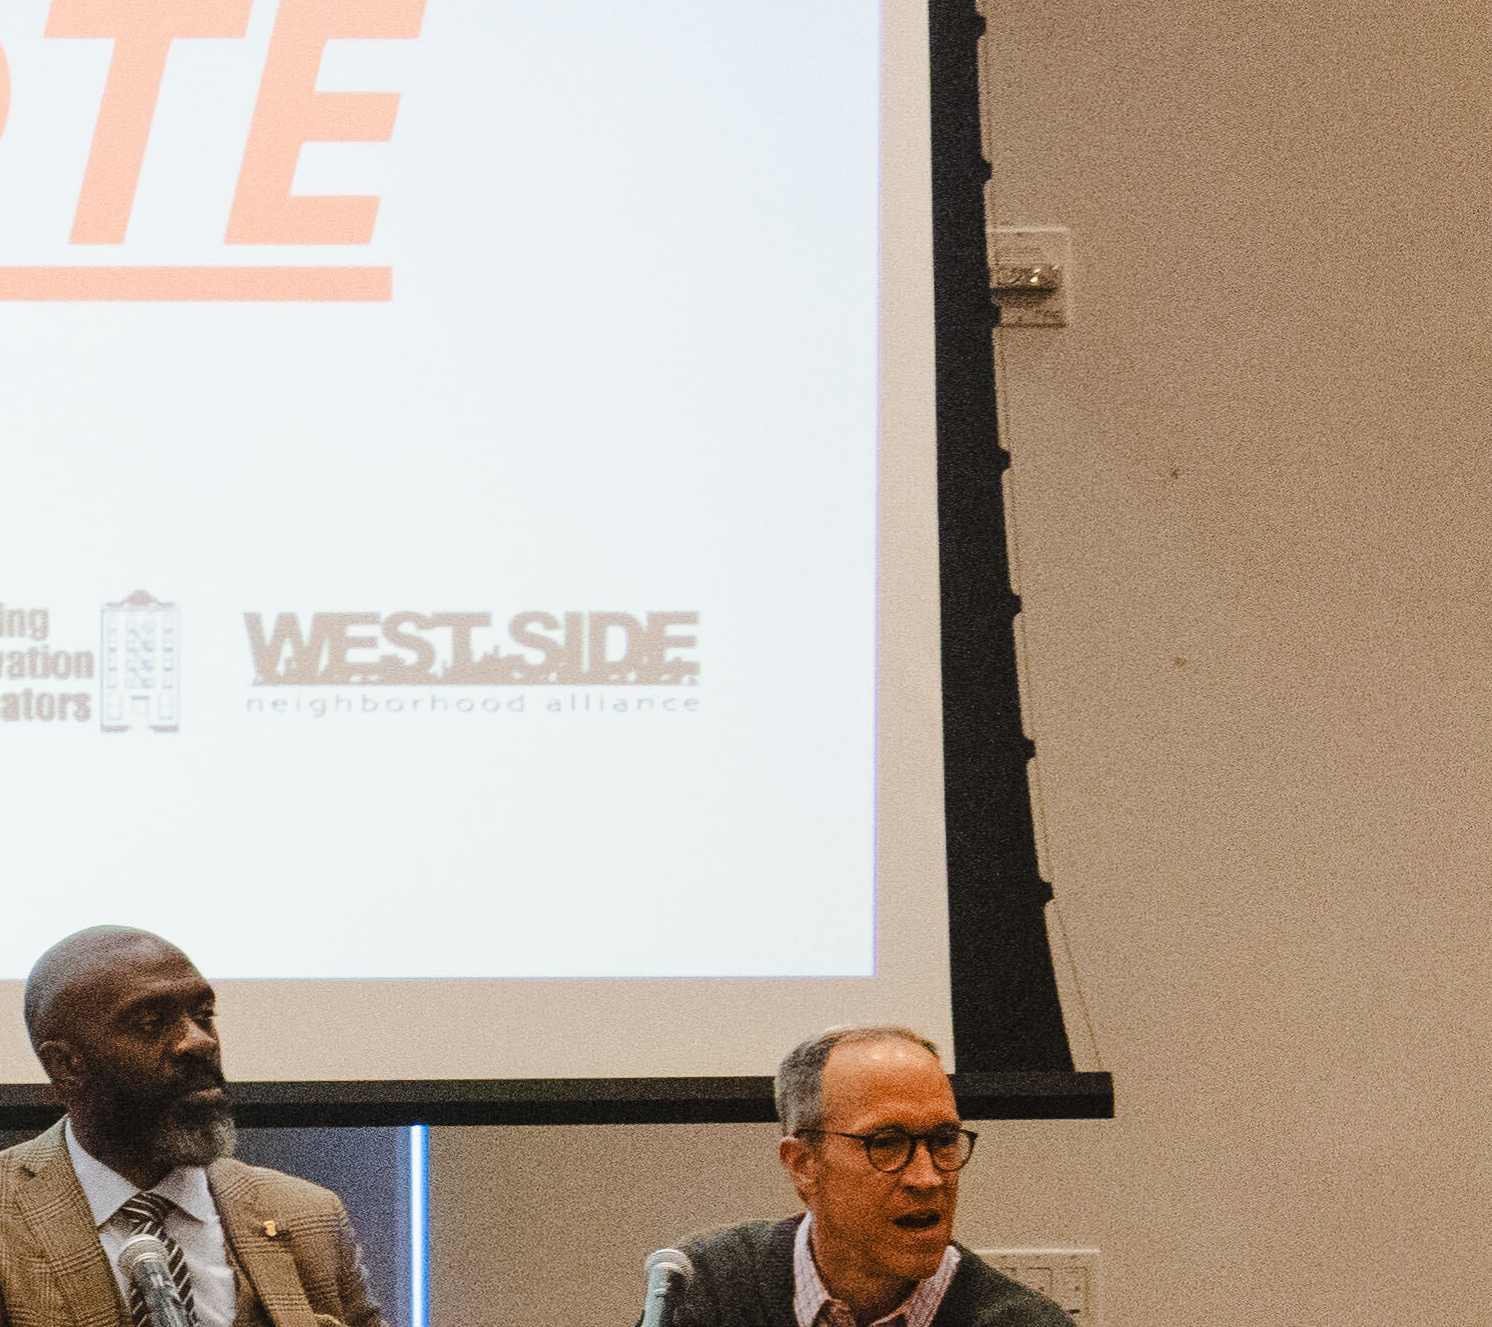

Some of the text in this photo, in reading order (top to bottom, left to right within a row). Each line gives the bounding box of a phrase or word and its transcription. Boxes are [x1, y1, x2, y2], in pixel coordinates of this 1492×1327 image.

[243, 610, 702, 686] WEST SIDE
[245, 691, 702, 718] neighborhood alliance
